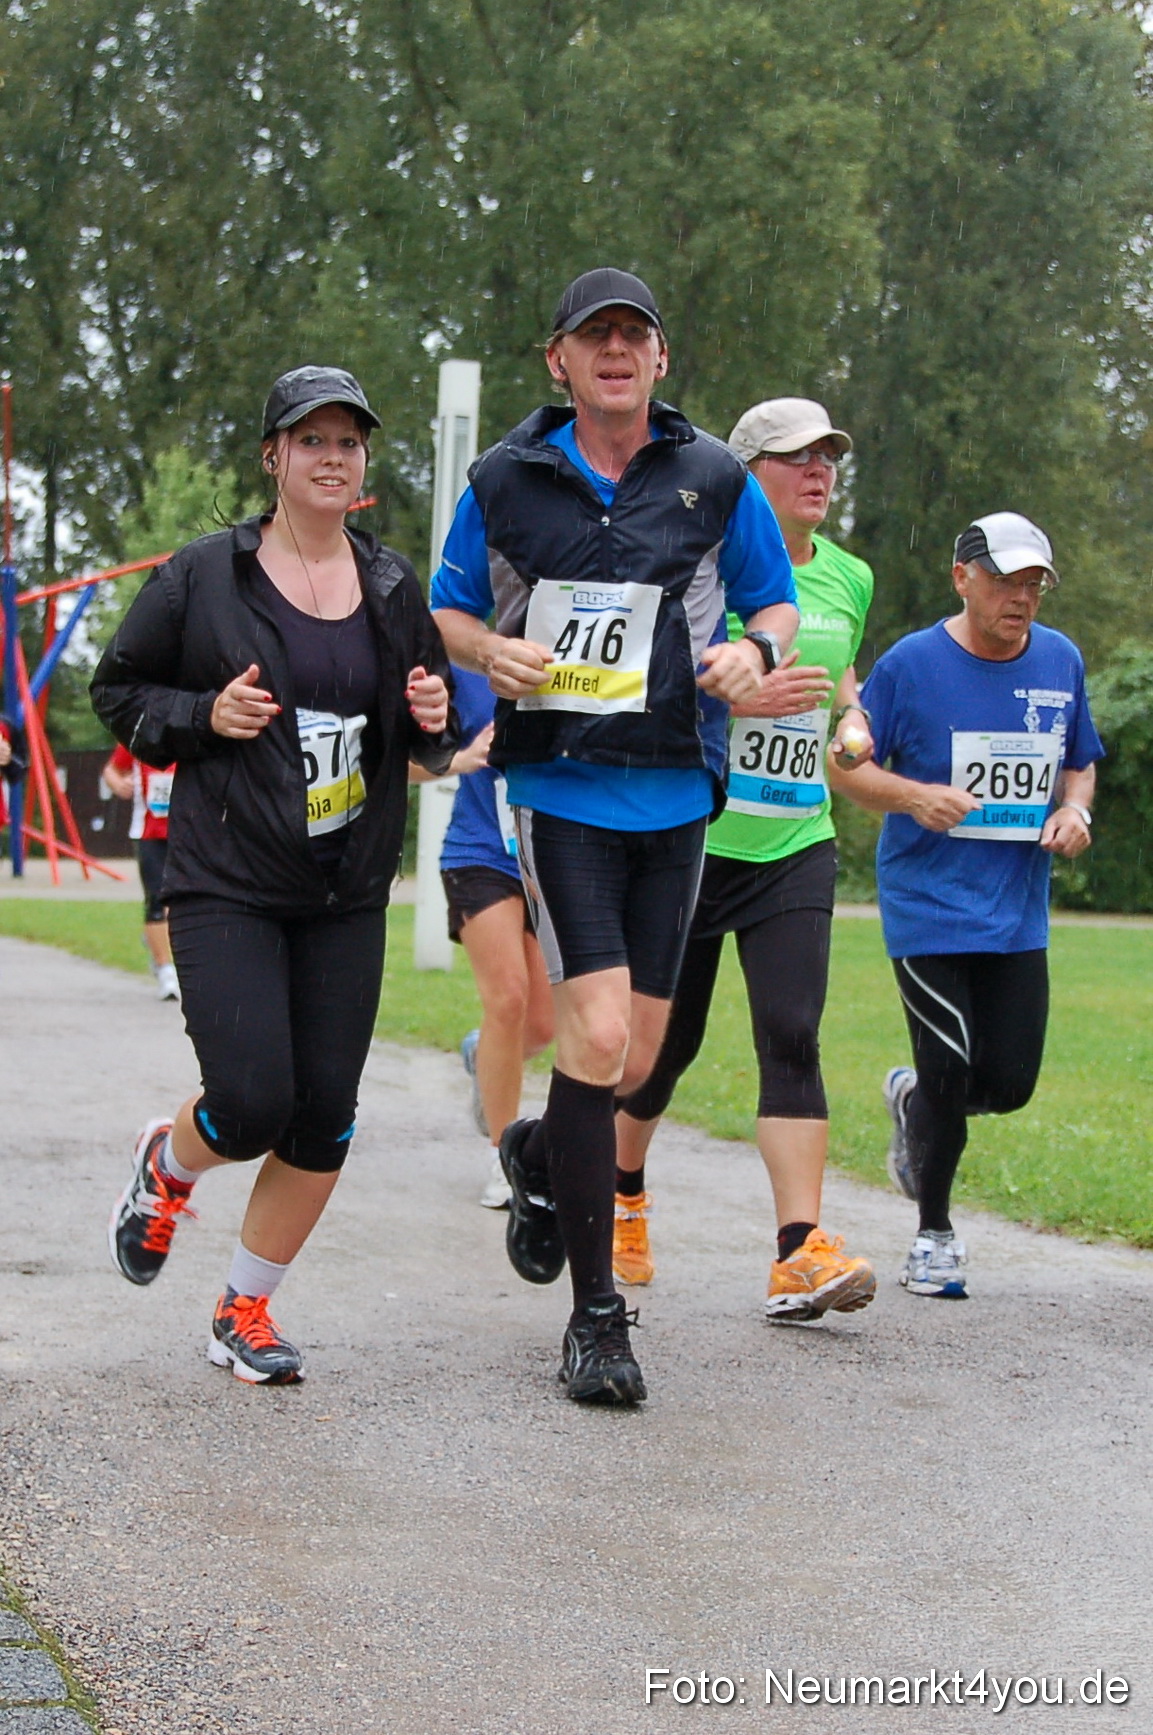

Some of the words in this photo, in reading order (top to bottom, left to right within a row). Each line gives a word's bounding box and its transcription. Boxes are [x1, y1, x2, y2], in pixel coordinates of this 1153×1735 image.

[553, 618, 627, 665] 416
[551, 671, 600, 694] Alfred
[739, 730, 819, 779] 3086
[966, 761, 1051, 800] 2694
[982, 809, 1036, 827] Ludwig
